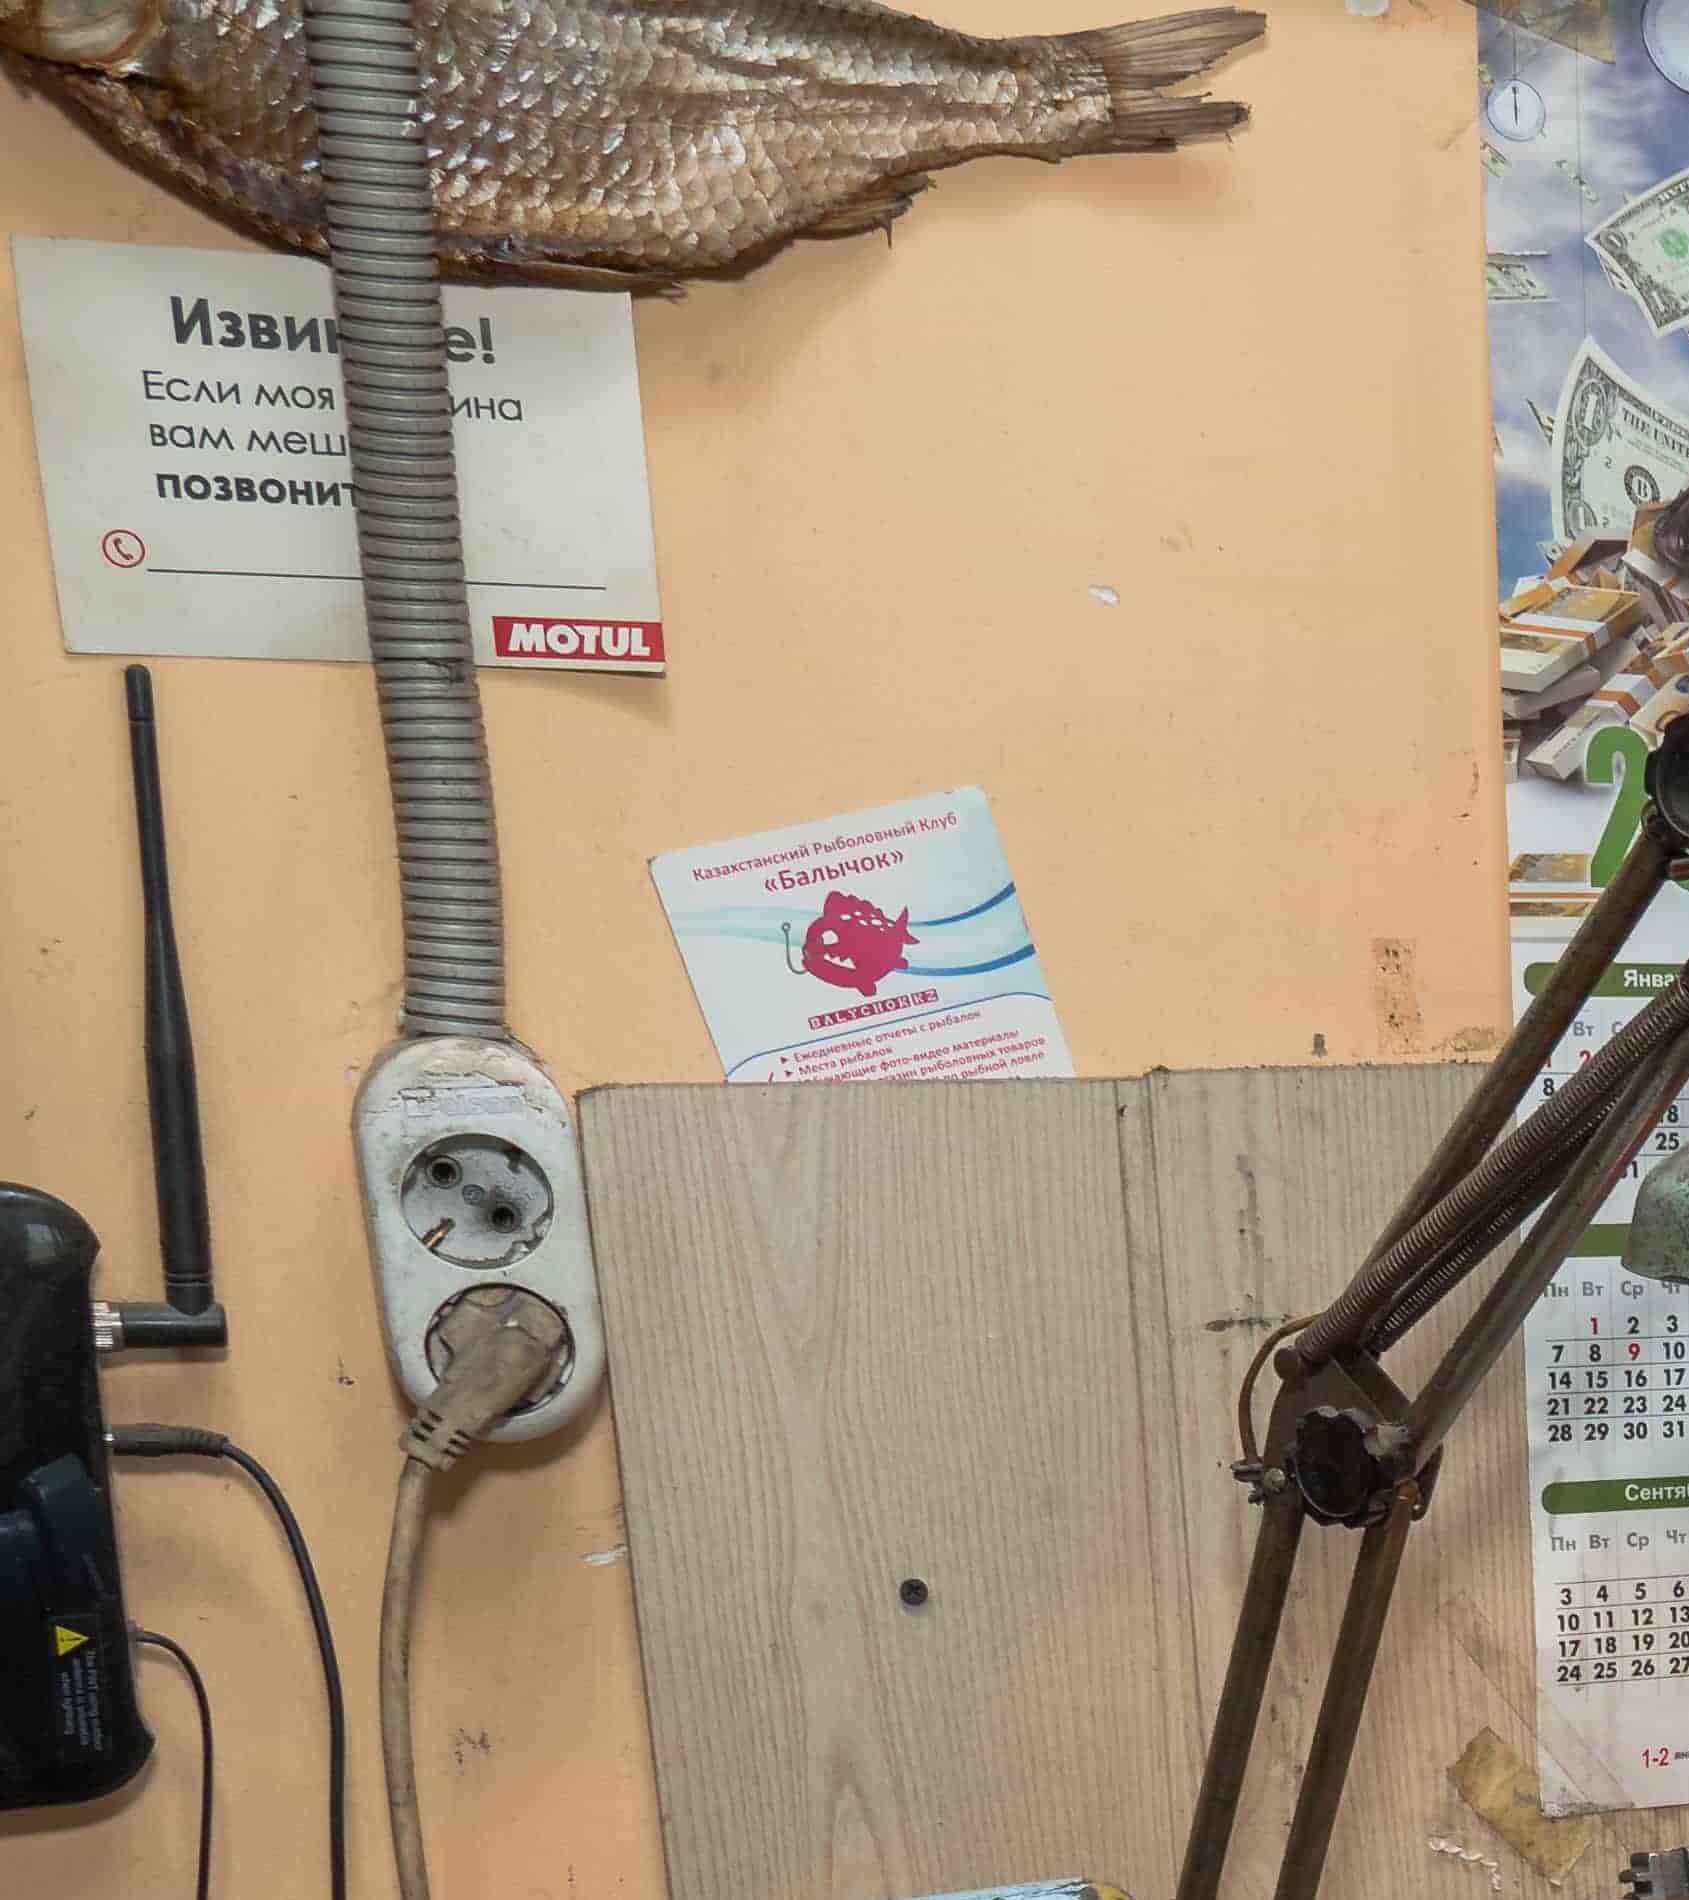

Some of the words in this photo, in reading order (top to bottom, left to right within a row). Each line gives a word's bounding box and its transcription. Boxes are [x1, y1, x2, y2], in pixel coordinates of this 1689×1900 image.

[170, 296, 496, 364] Извие!
[142, 370, 241, 405] Если
[256, 384, 335, 411] моя
[448, 395, 523, 422] ина
[150, 426, 234, 452] вам
[248, 435, 348, 457] меш
[156, 473, 359, 507] позвони
[508, 623, 652, 657] MOTUL
[691, 847, 810, 882] Казахстанский
[812, 821, 916, 856] Рыболовный
[918, 811, 959, 834] Клуб
[764, 849, 905, 893] «Балычок»
[1623, 969, 1680, 989] Янва
[1654, 1132, 1681, 1151] 25
[1548, 1371, 1573, 1390] 14
[1585, 1370, 1609, 1389] 15
[1624, 1369, 1648, 1388] 16
[1663, 1367, 1686, 1387] 17
[1546, 1397, 1570, 1417] 21
[1583, 1396, 1609, 1415] 22
[1623, 1395, 1648, 1414] 23
[1662, 1394, 1687, 1413] 24
[1557, 1613, 1580, 1633] 10
[1593, 1610, 1614, 1629] 11
[1631, 1607, 1654, 1626] 12
[1641, 1747, 1670, 1769] 1-2
